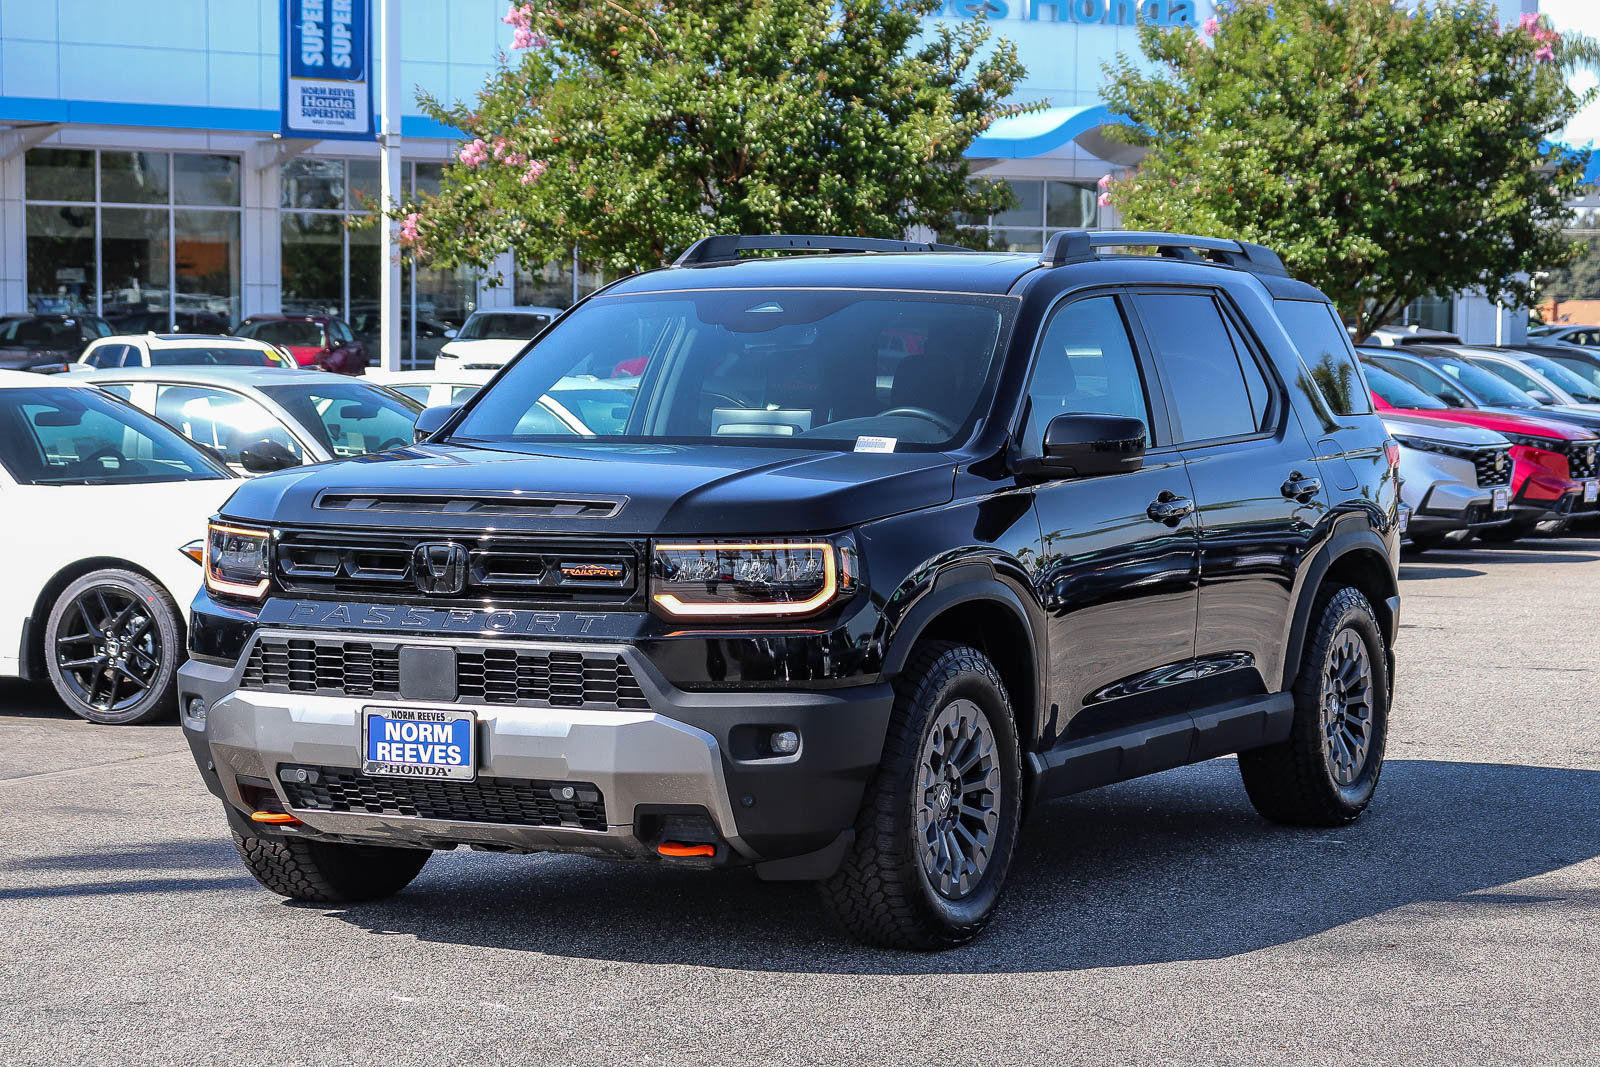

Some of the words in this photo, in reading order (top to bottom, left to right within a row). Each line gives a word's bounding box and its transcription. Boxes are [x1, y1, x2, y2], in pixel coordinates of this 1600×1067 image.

[301, 0, 324, 66] SUPER
[332, 0, 352, 69] SUPER
[304, 96, 353, 108] Honda
[302, 109, 356, 120] SUPERSTORE
[561, 568, 621, 577] TRAILSPORT
[288, 602, 607, 634] PASSPORT
[391, 710, 415, 720] NORM
[417, 712, 445, 722] REEVES
[385, 722, 453, 743] NORM
[377, 742, 461, 765] REEVES
[389, 764, 448, 777] HONDA
